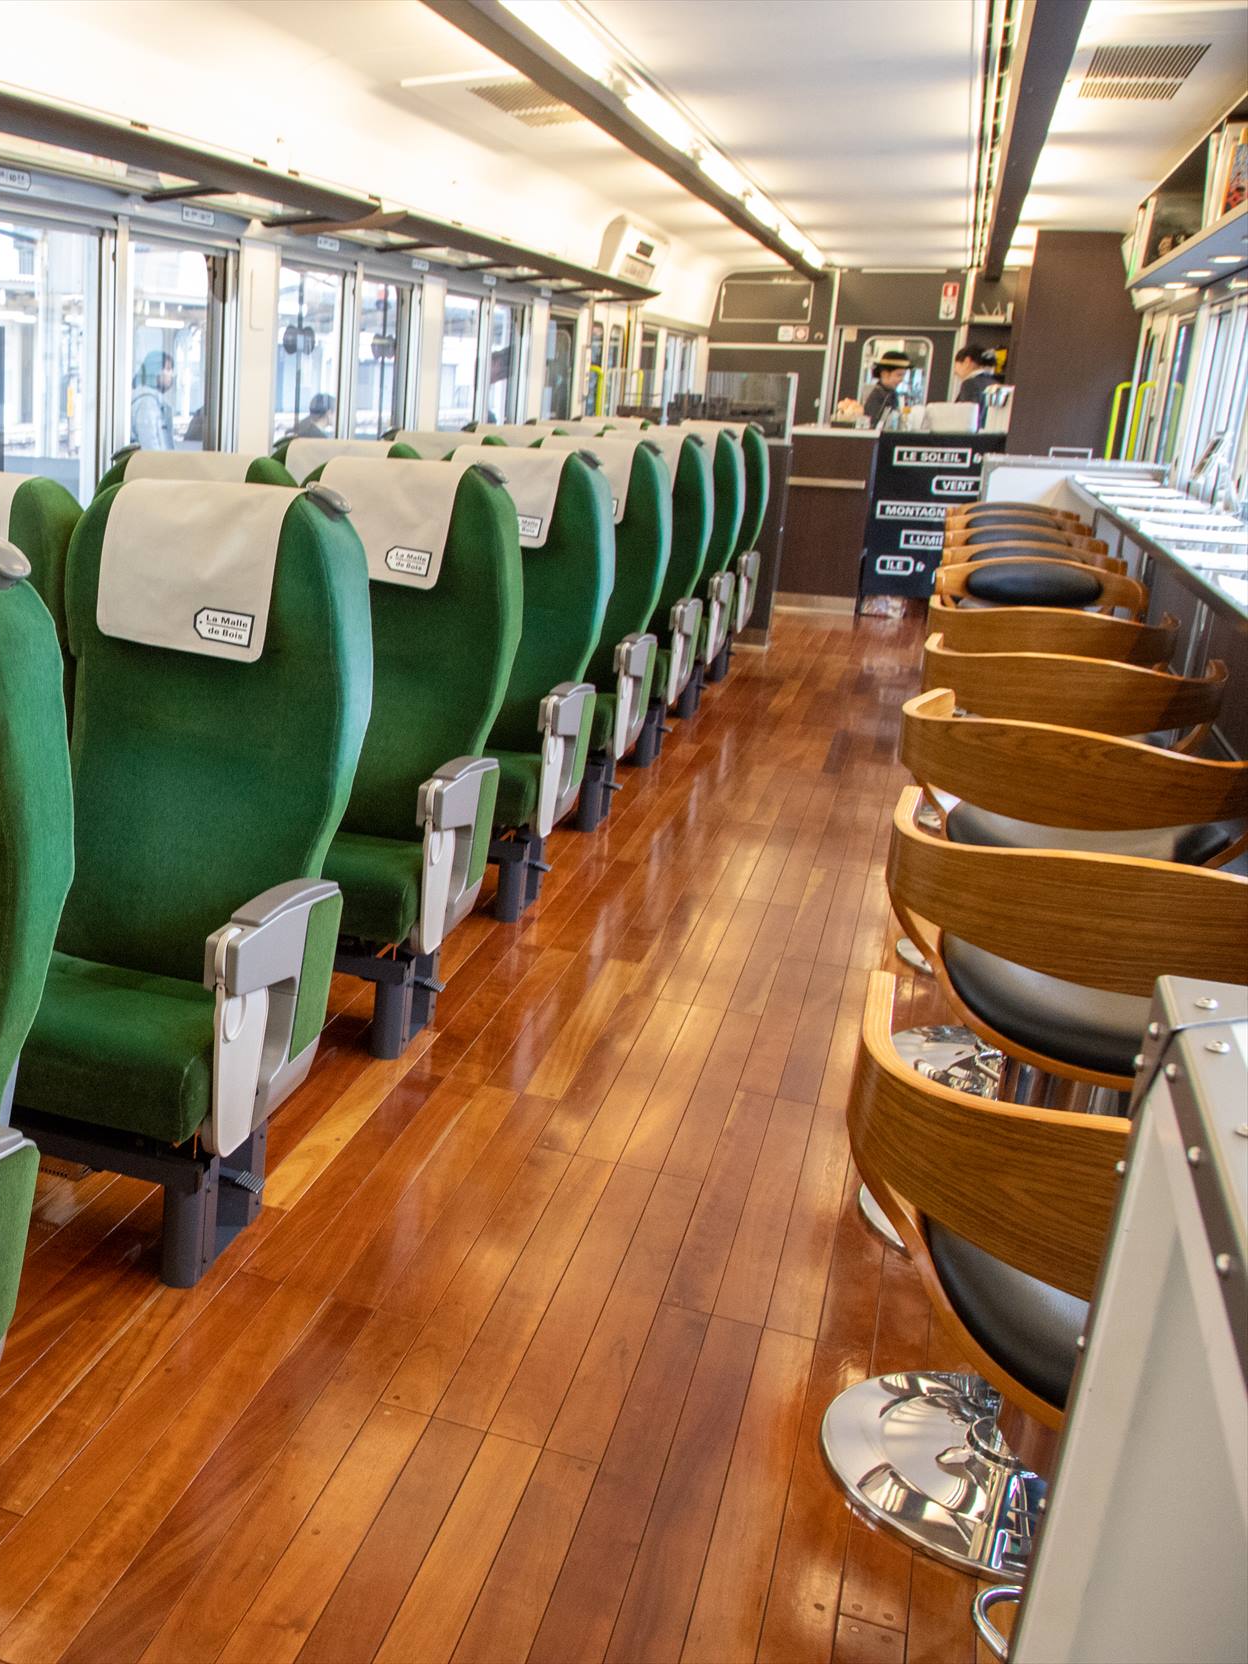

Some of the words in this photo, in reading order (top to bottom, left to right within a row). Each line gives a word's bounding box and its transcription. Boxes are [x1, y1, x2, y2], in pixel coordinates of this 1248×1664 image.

[902, 451, 917, 463] LE
[920, 451, 962, 463] SOLEIL
[942, 480, 975, 491] VENT
[206, 614, 218, 623] La
[221, 616, 248, 628] Malle
[208, 627, 220, 635] de
[222, 629, 243, 640] Bois
